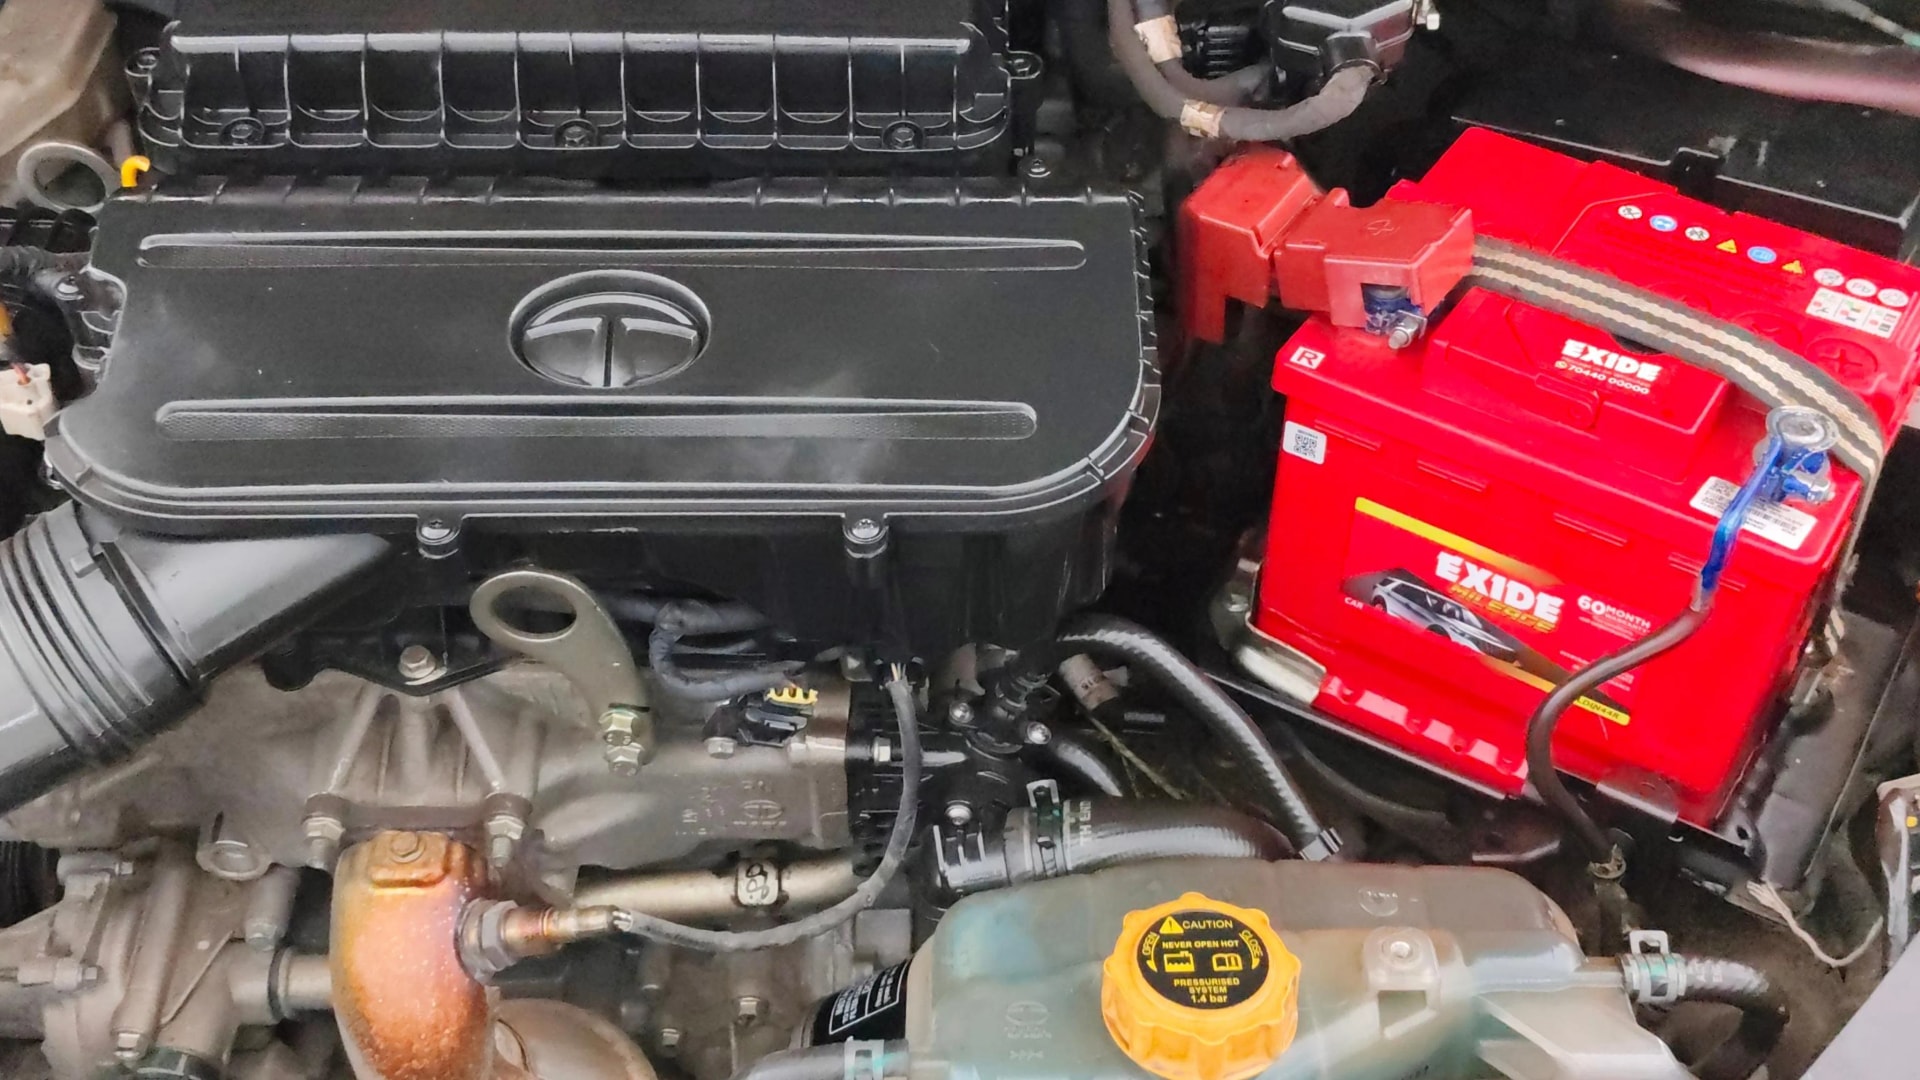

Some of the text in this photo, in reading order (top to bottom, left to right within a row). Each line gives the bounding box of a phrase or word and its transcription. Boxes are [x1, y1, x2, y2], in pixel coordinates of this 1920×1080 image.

[1297, 350, 1318, 366] R
[1561, 338, 1663, 382] EXIDE
[1568, 364, 1606, 381] 70440
[1608, 377, 1650, 395] 00000
[1435, 551, 1565, 623] EXIDE
[1344, 597, 1364, 610] CAR
[1577, 594, 1606, 616] 60
[1606, 604, 1651, 629] MONTH
[1182, 919, 1233, 929] CAUTION
[1142, 931, 1158, 956] OPEN
[1162, 939, 1239, 949] NEVER OPEN HOT
[1241, 929, 1264, 958] CLOSE
[1173, 977, 1240, 987] PRESSURISED
[1188, 986, 1228, 995] SYSTEM
[1191, 993, 1228, 1004] 1.4 bar
